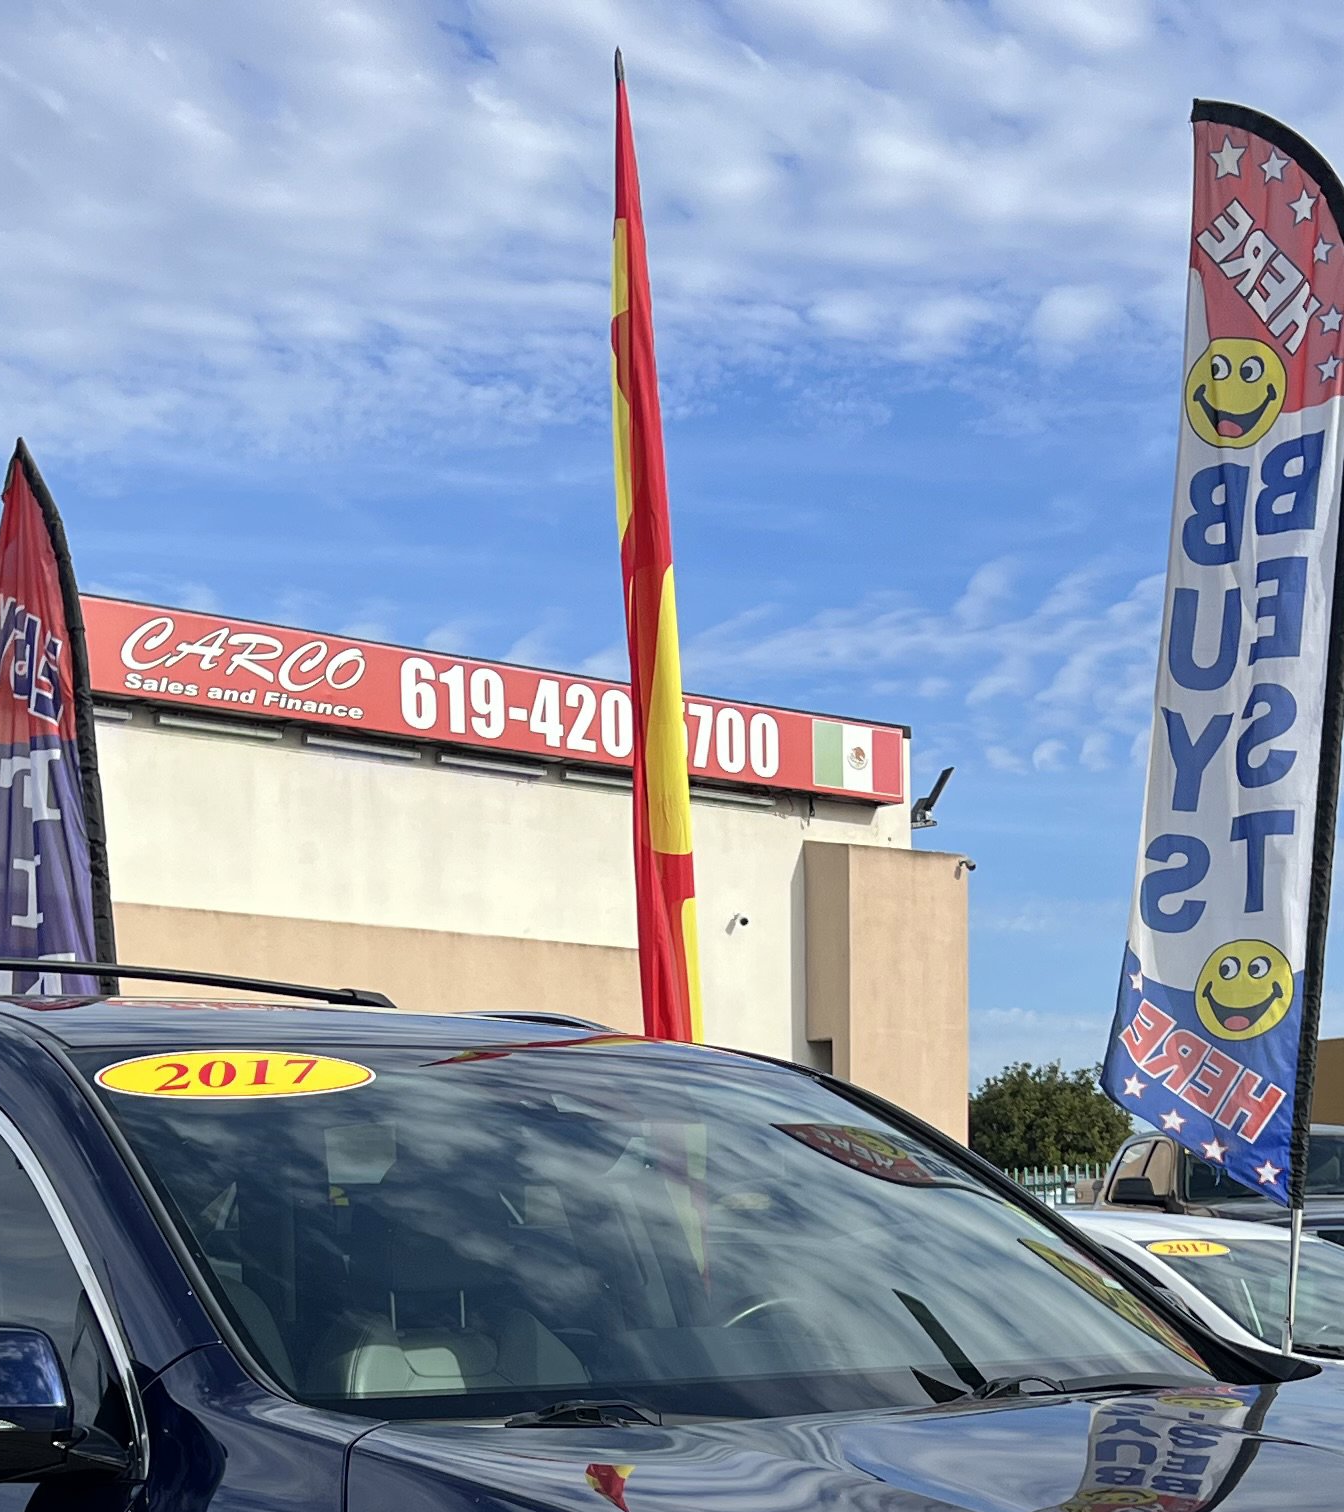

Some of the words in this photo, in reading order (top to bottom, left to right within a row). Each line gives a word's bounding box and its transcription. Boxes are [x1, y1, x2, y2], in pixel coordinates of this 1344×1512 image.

[120, 616, 366, 693] CARCO
[124, 672, 200, 697] Sales
[207, 686, 257, 704] and
[263, 691, 364, 720] Finance
[400, 657, 779, 779] 619-420700
[154, 1059, 318, 1092] 2017
[1163, 1242, 1210, 1254] 2017
